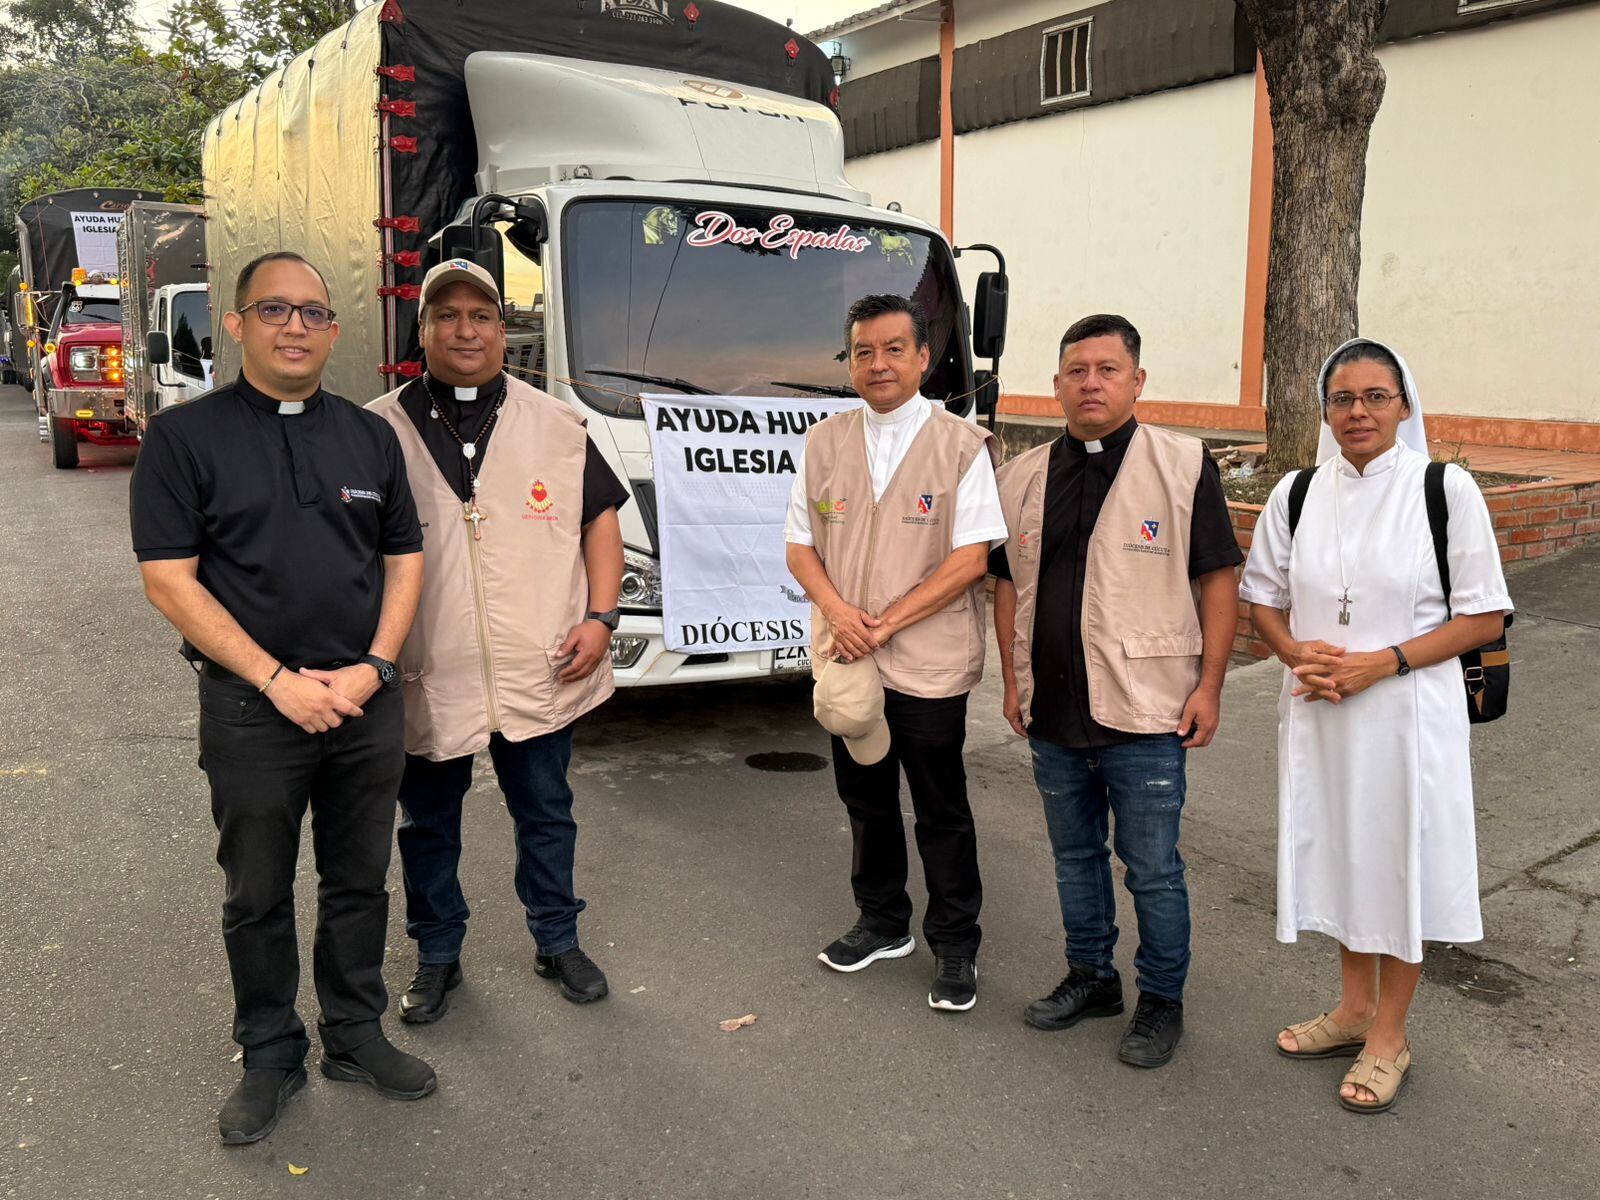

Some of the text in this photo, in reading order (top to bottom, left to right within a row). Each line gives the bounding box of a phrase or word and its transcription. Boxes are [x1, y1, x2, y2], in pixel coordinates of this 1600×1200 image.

[74, 215, 106, 223] AYUDA
[686, 210, 872, 260] Dos Espadas
[656, 407, 842, 435] AYUDA HUM
[684, 446, 798, 474] IGLESIA
[681, 616, 804, 646] DIÓCESIS
